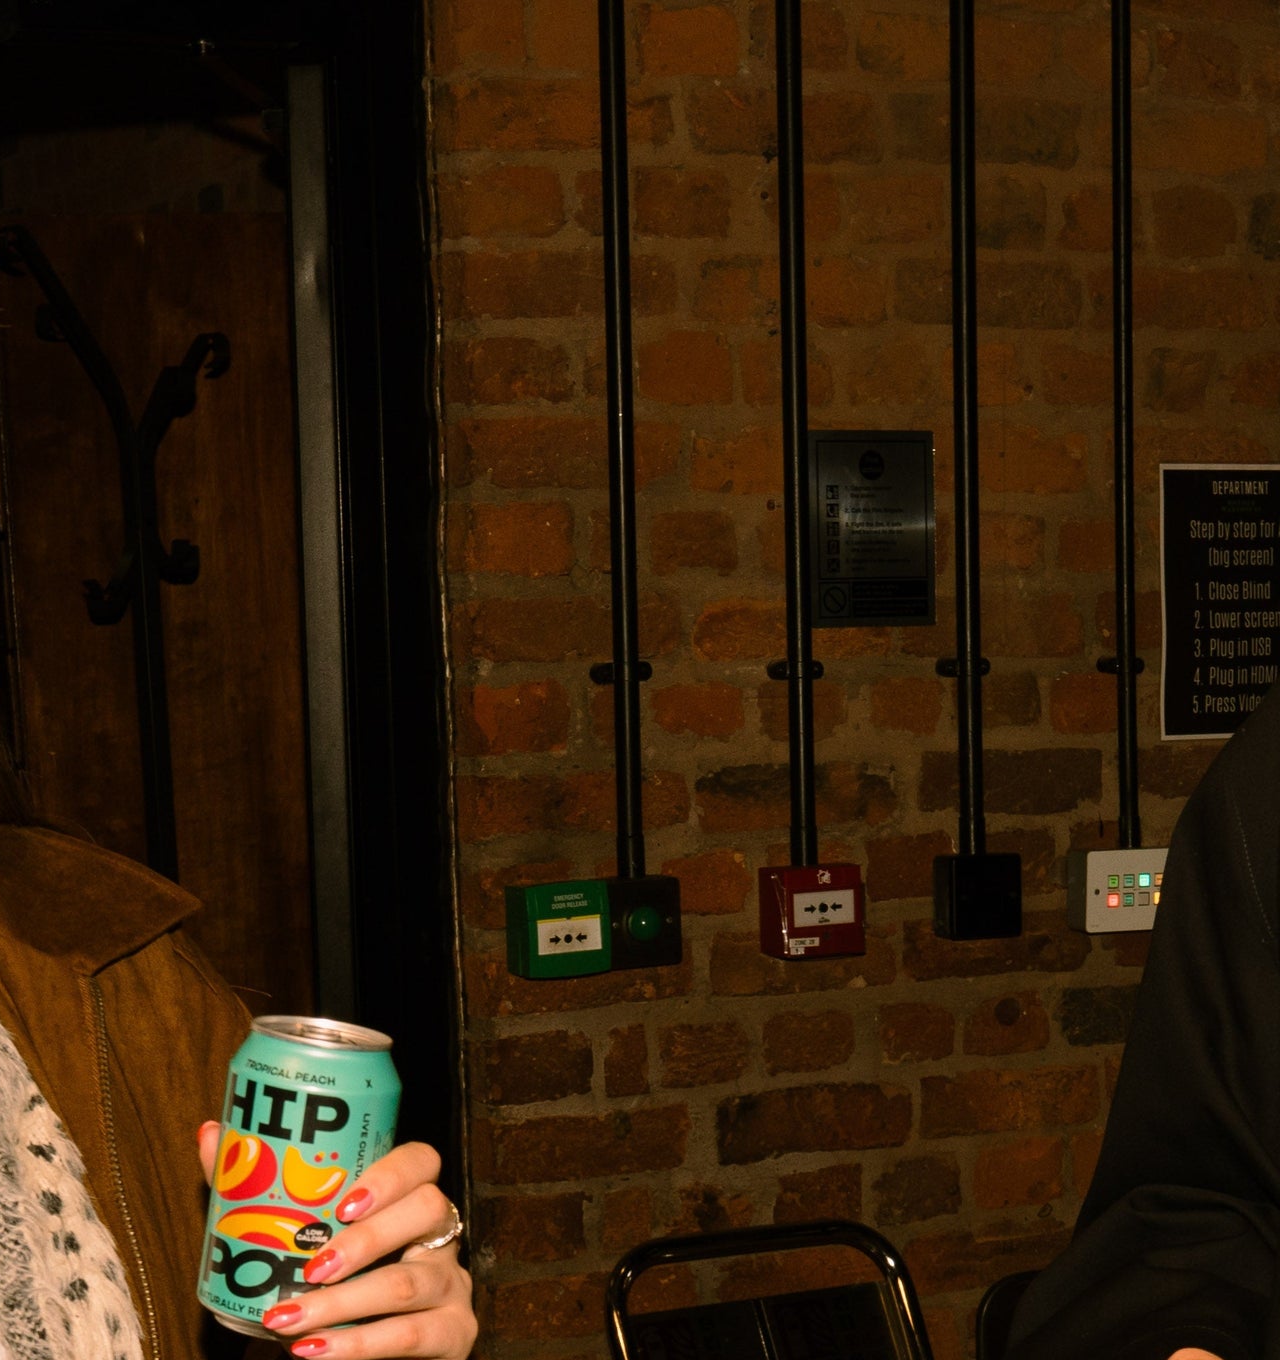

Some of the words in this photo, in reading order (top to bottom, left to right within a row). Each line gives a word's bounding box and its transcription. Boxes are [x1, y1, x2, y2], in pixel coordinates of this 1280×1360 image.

[1212, 480, 1270, 496] DEPARTMENT
[1190, 519, 1214, 539] Step
[1218, 519, 1231, 539] by
[1233, 520, 1256, 539] step
[1260, 519, 1275, 538] for
[1194, 582, 1204, 601] 1.
[1208, 581, 1240, 601] Close
[1242, 580, 1271, 600] Blind
[1194, 610, 1204, 629] 2.
[1209, 610, 1241, 629] Lower
[1193, 638, 1204, 658] 3.
[1209, 638, 1235, 659] Plug
[1238, 638, 1249, 657] in
[1251, 637, 1272, 656] USB
[1193, 667, 1204, 686] 4.
[1209, 666, 1235, 688] Plug
[1238, 666, 1249, 685] in
[1192, 695, 1203, 714] 5.
[1204, 694, 1236, 713] Press
[246, 1058, 291, 1080] TROPICAL
[294, 1072, 336, 1086] PEACH
[228, 1072, 351, 1145] HIP
[360, 1112, 371, 1138] LIVE
